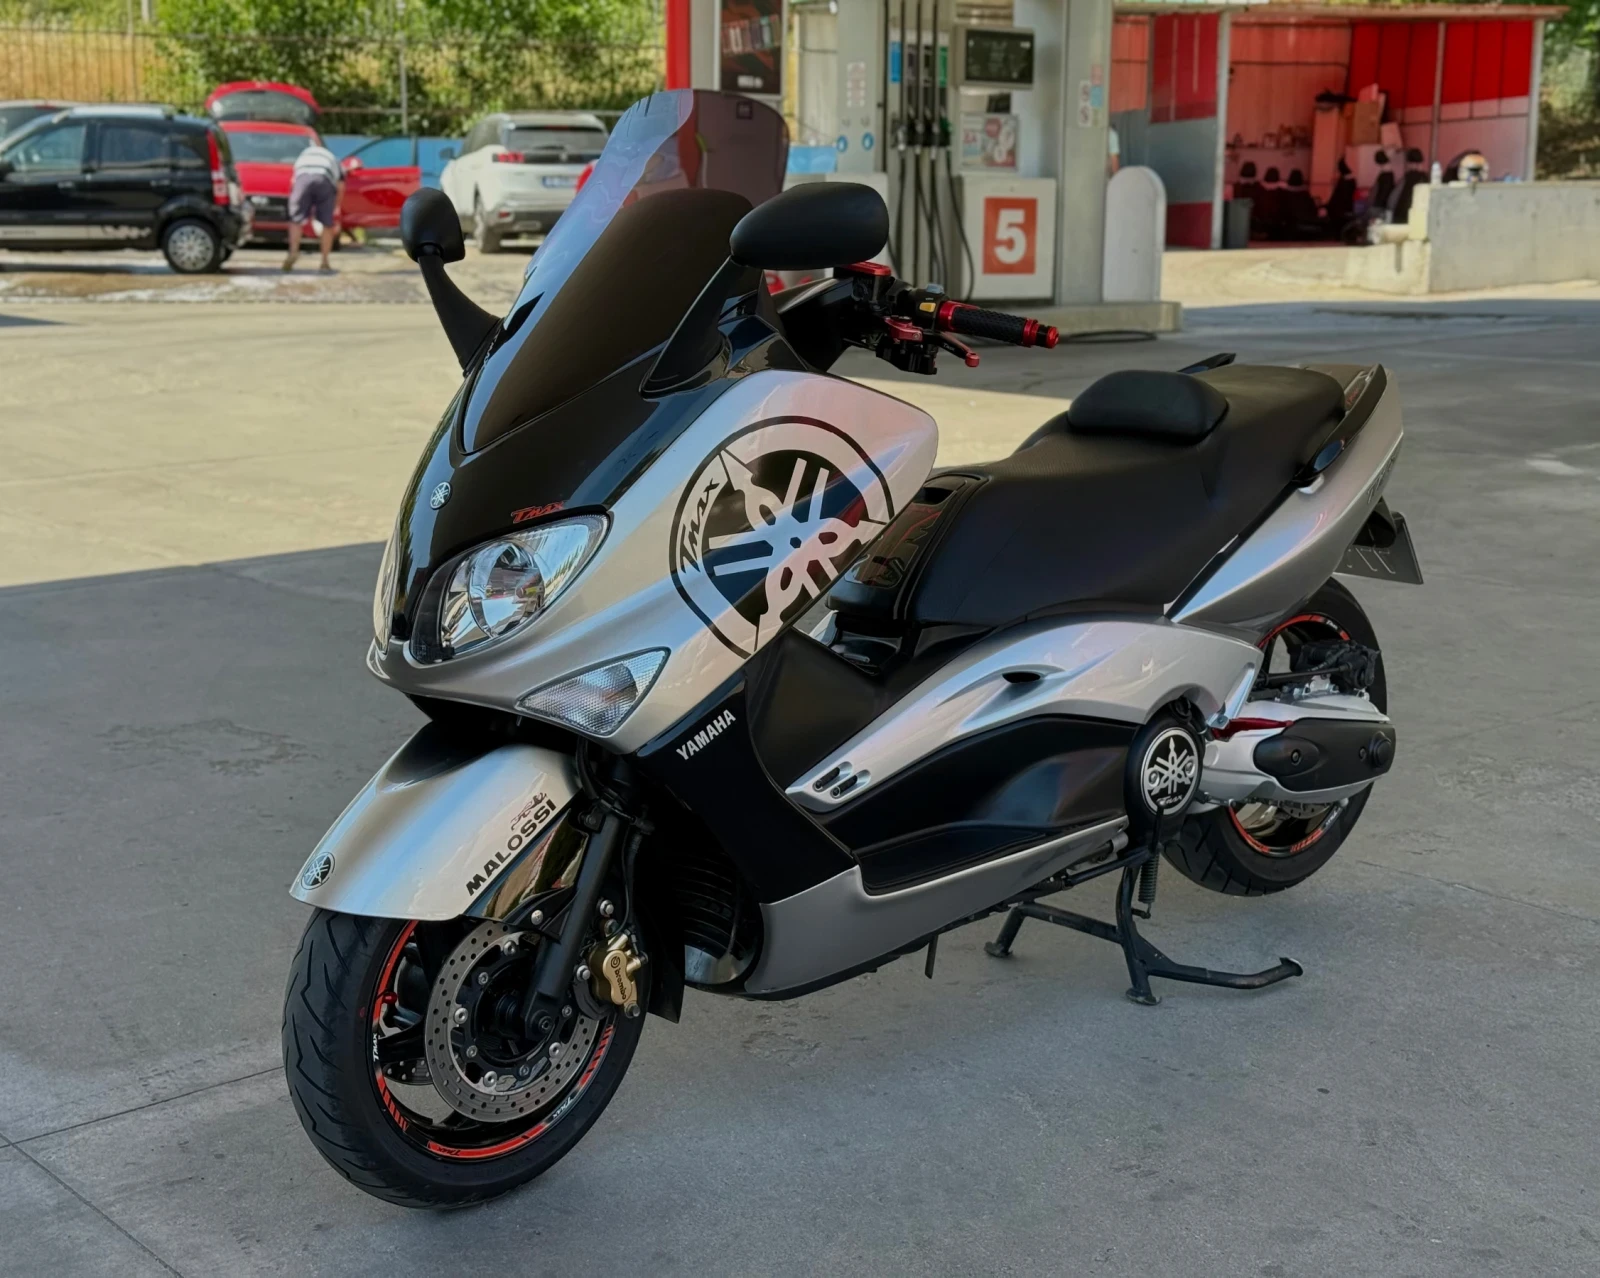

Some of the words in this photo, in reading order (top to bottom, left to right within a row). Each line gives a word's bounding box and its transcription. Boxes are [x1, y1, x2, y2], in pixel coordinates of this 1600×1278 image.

[994, 208, 1027, 264] 5
[676, 709, 736, 760] YAMAHA
[466, 799, 557, 896] MALOSSI
[614, 967, 627, 1000] brembo
